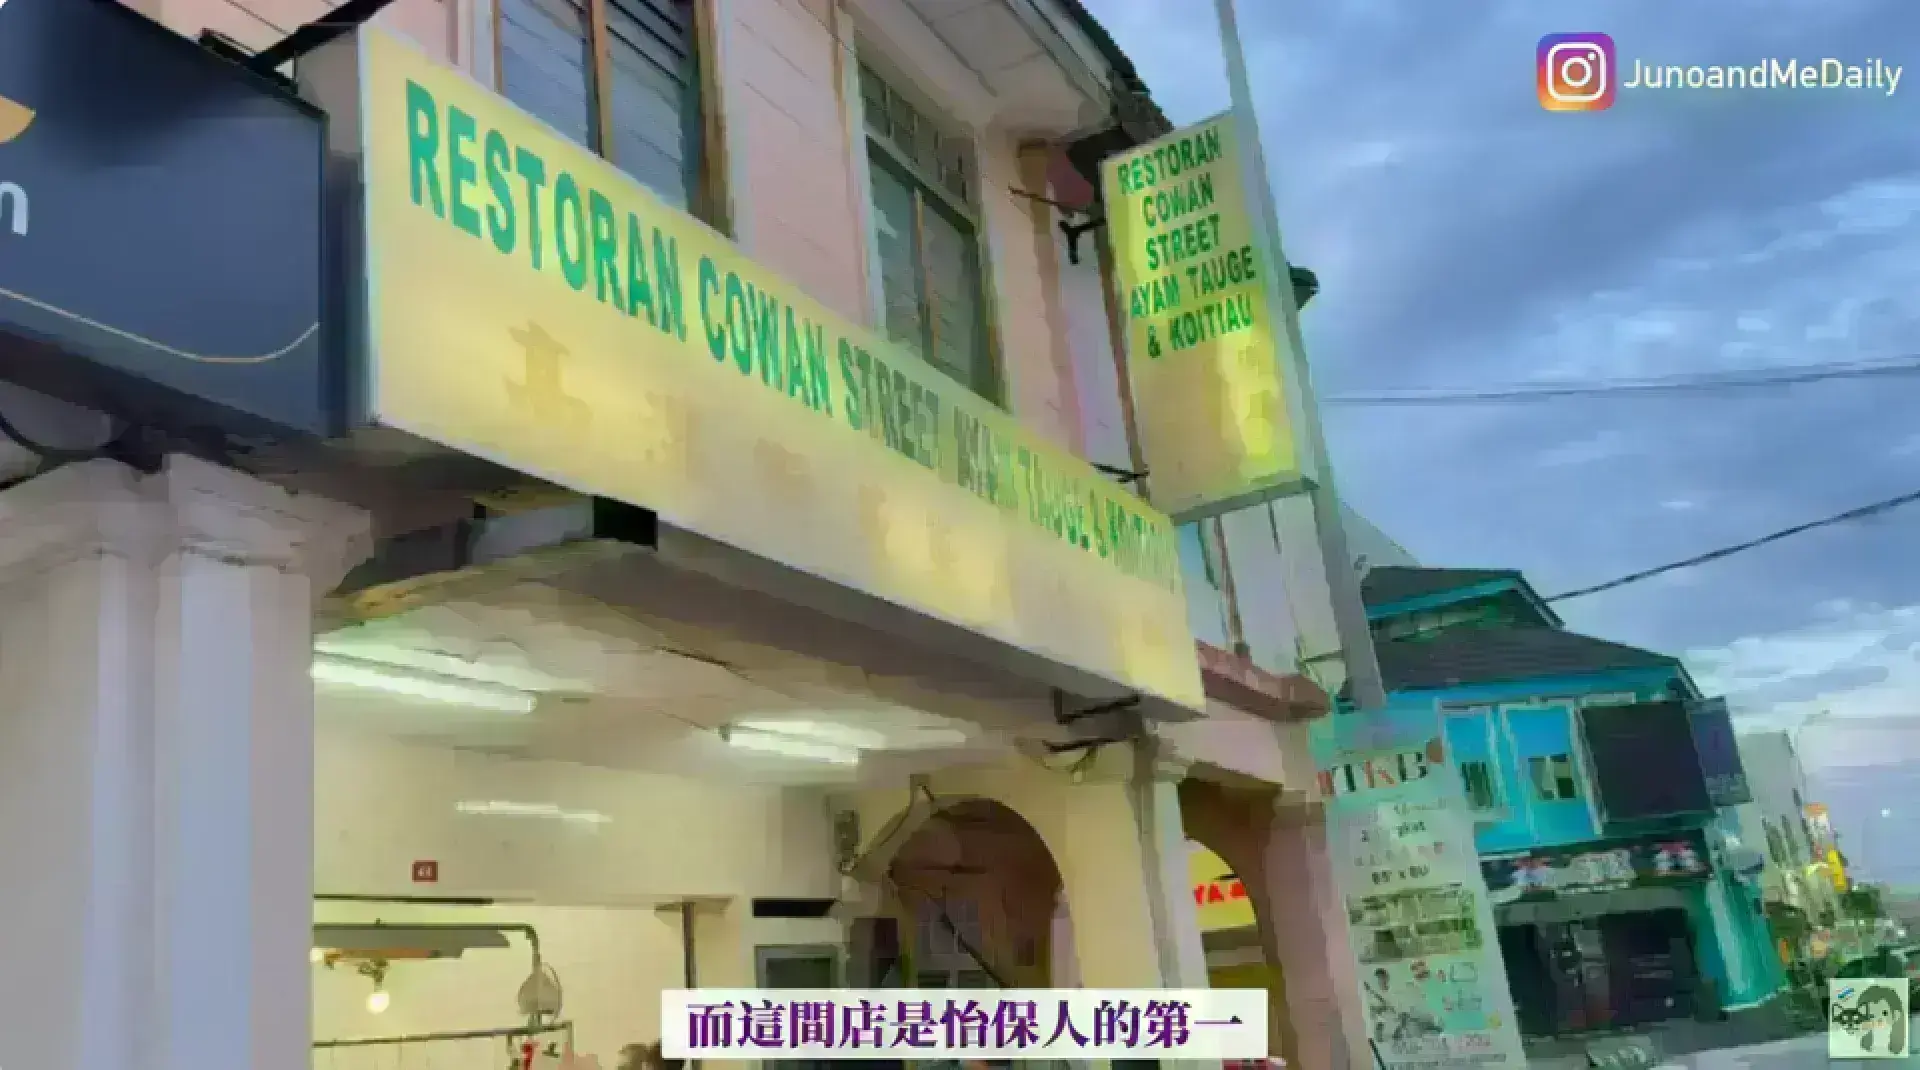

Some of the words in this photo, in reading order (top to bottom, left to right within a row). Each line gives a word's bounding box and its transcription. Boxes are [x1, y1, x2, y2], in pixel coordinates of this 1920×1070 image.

[1117, 125, 1222, 195] RESTORAN
[1142, 172, 1215, 229] COWAN
[406, 78, 687, 342] RESTORAN
[698, 254, 832, 418] COWAN
[837, 336, 941, 470] STREET
[1145, 213, 1221, 271] STREET
[1129, 274, 1181, 319] AYAM
[1186, 244, 1257, 301] TAUGE
[1146, 325, 1162, 359] &
[1168, 292, 1254, 351] KOITIAU
